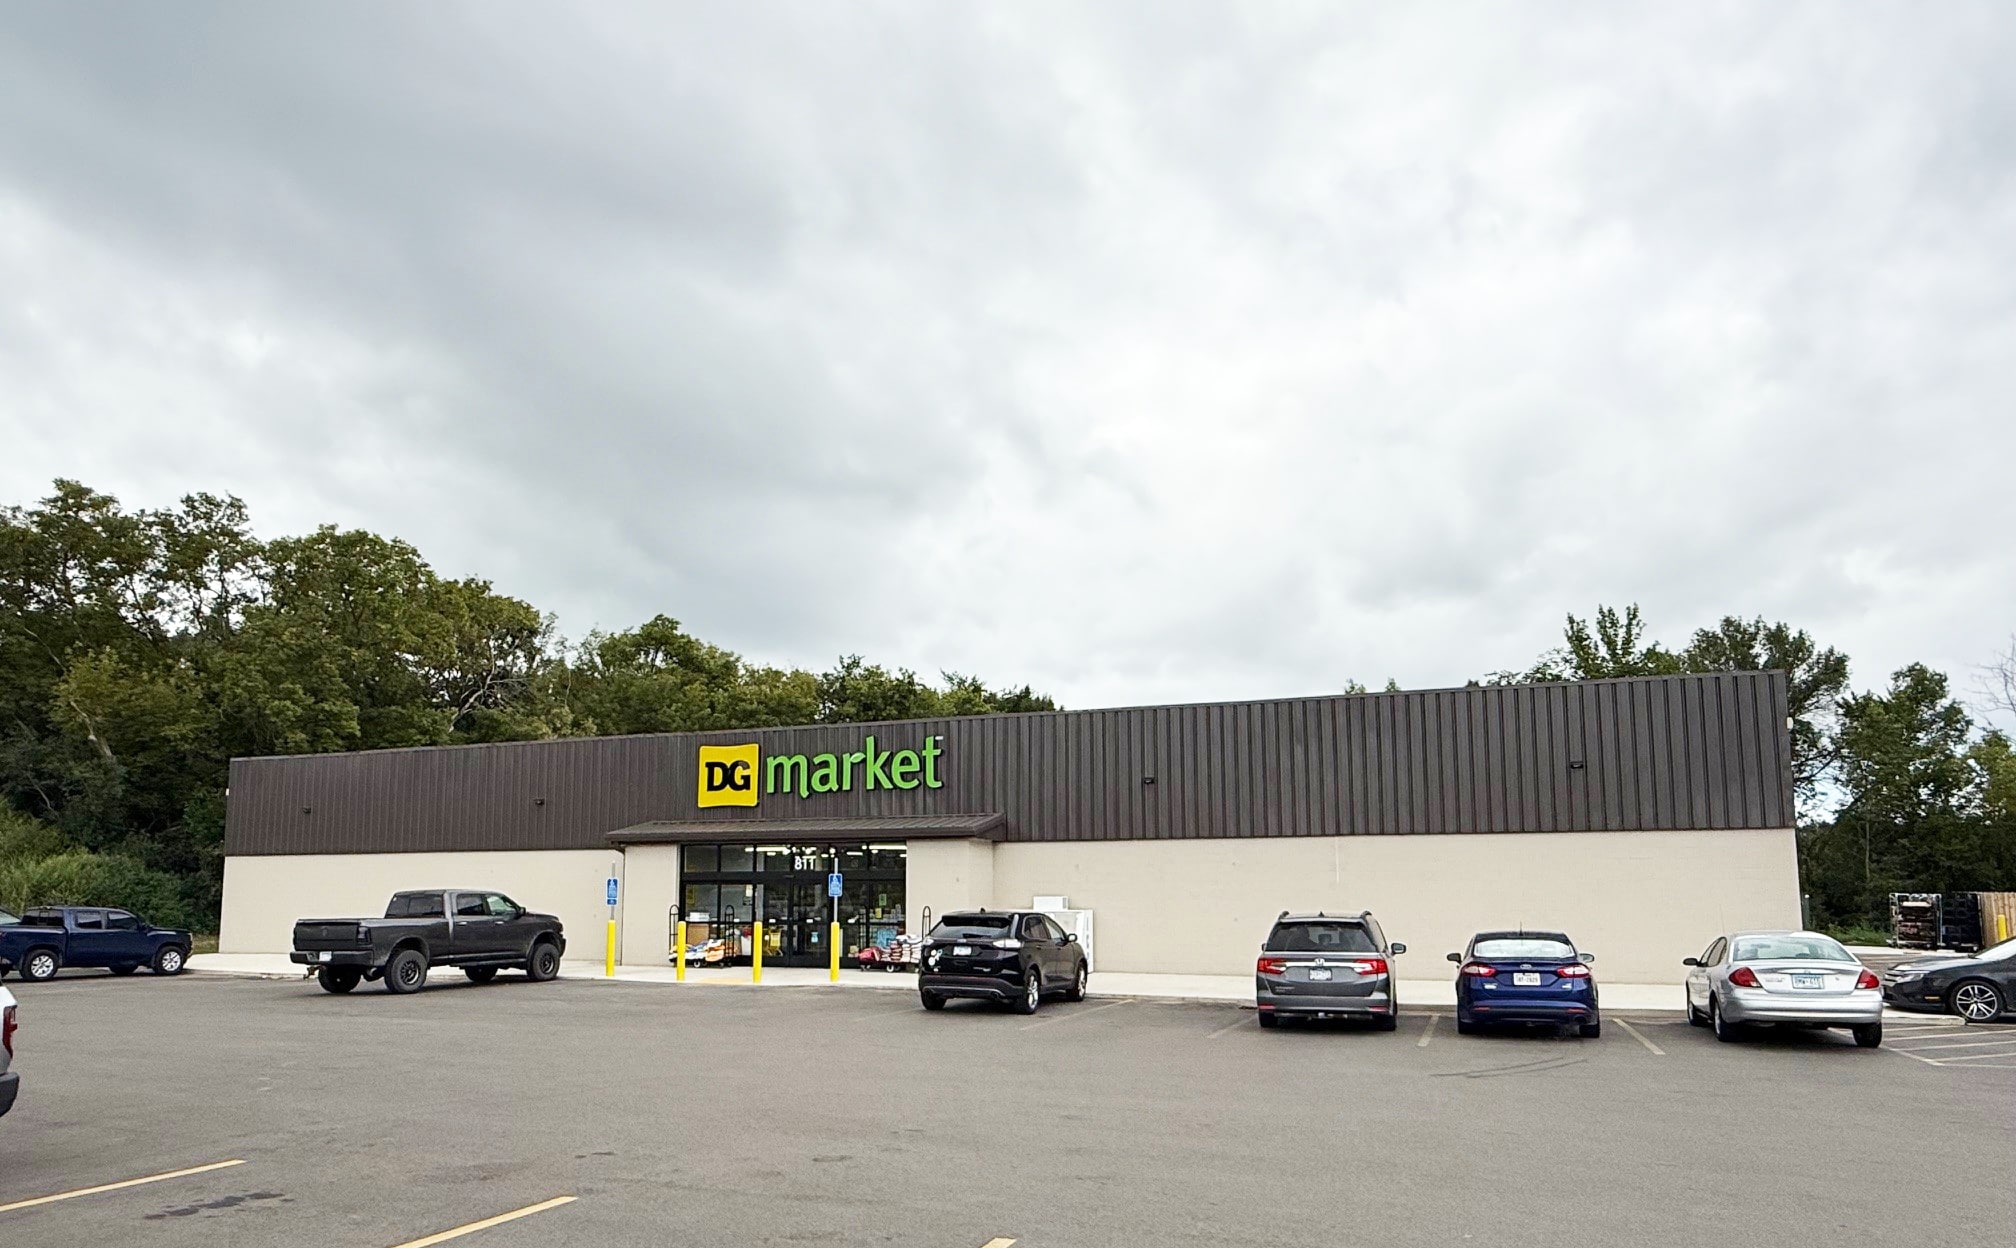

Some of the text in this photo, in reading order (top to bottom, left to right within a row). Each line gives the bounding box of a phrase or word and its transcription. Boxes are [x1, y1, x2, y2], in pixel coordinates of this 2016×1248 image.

[705, 735, 942, 797] DG market
[794, 857, 814, 870] 811
